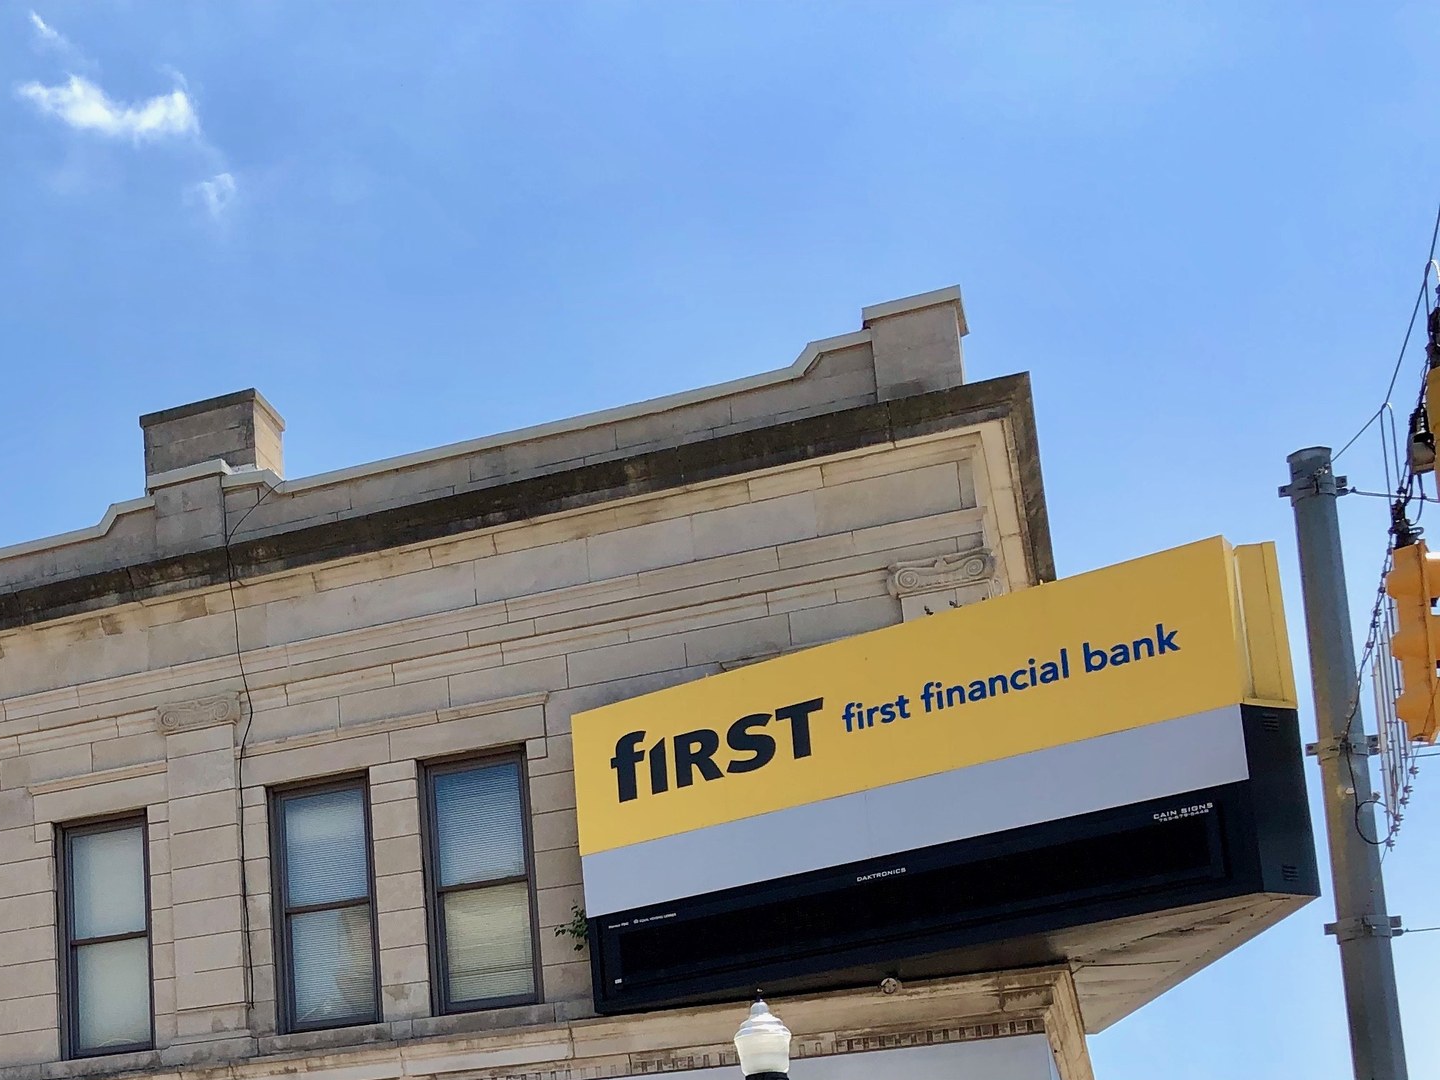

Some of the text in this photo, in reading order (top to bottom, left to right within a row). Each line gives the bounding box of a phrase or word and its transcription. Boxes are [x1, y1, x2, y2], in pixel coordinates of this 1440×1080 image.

[842, 623, 1182, 733] first financial bank
[1153, 802, 1213, 819] CAIN SIGNS
